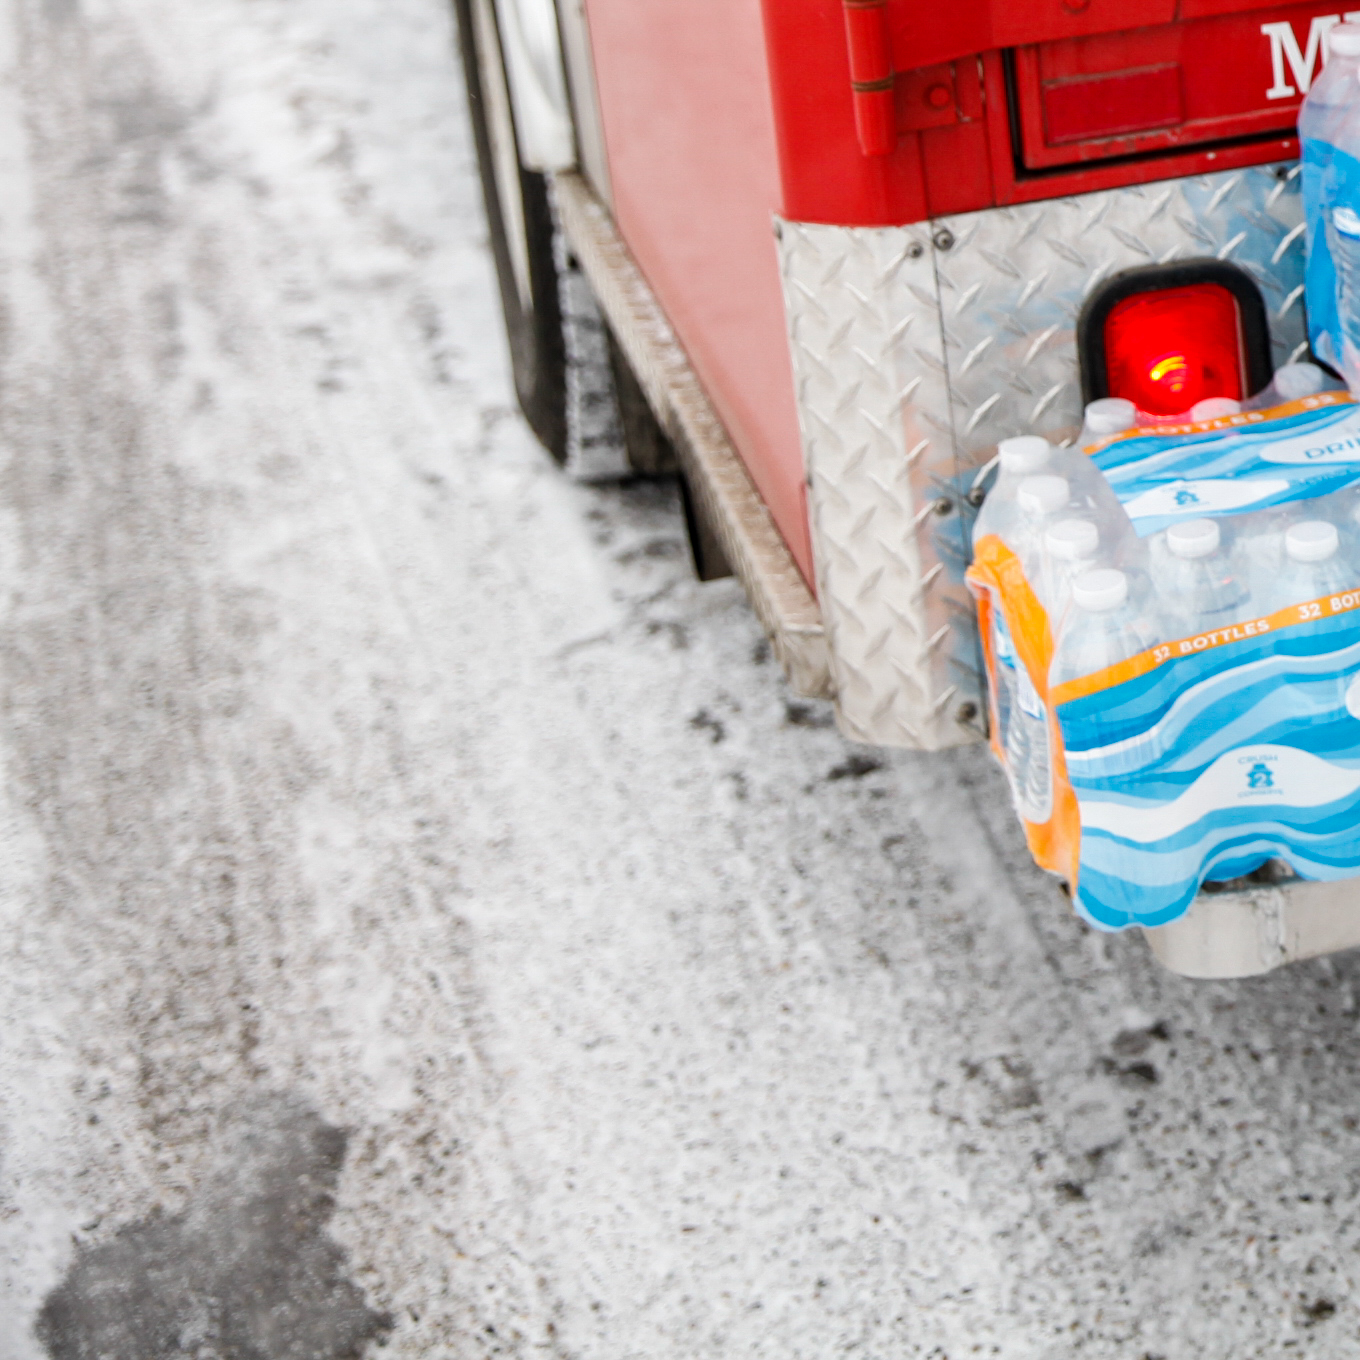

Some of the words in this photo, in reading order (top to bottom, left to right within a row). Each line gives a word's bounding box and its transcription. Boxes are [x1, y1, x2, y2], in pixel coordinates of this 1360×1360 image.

[1152, 646, 1172, 663] 32
[1179, 619, 1271, 654] BOTTLES
[1298, 603, 1323, 620] 32
